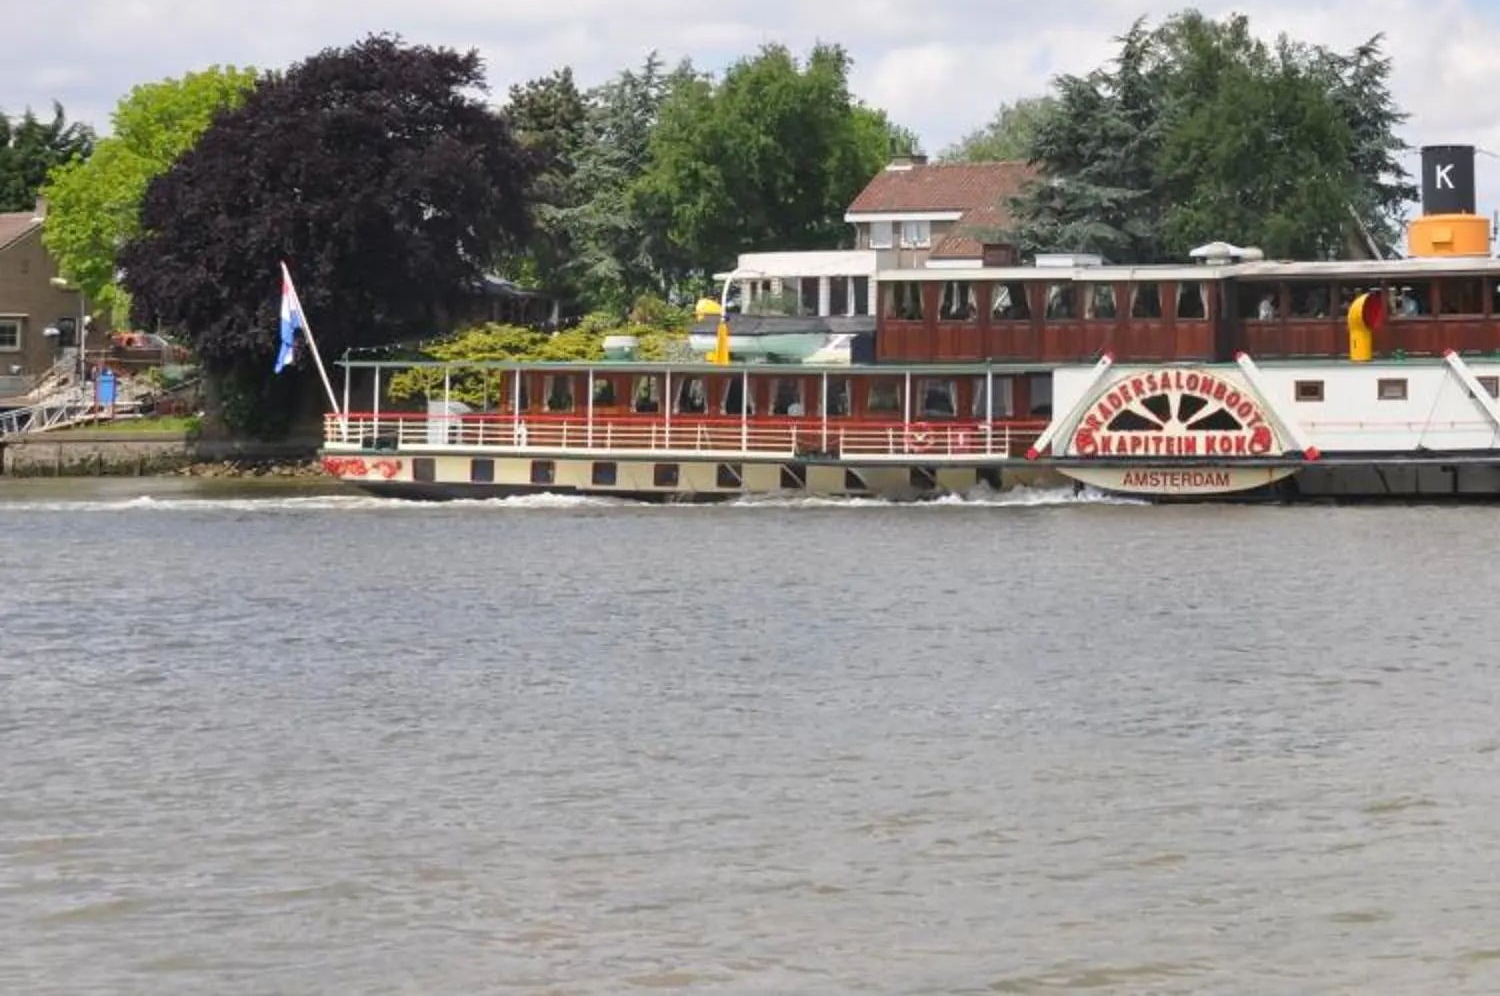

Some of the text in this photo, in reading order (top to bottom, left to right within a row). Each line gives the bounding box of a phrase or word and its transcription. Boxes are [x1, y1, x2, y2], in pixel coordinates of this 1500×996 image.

[1435, 163, 1456, 190] K
[1086, 370, 1265, 431] RADERSALONBOOT
[1101, 435, 1246, 453] KAPITEIN KOK
[1123, 471, 1231, 487] AMSTERDAM
